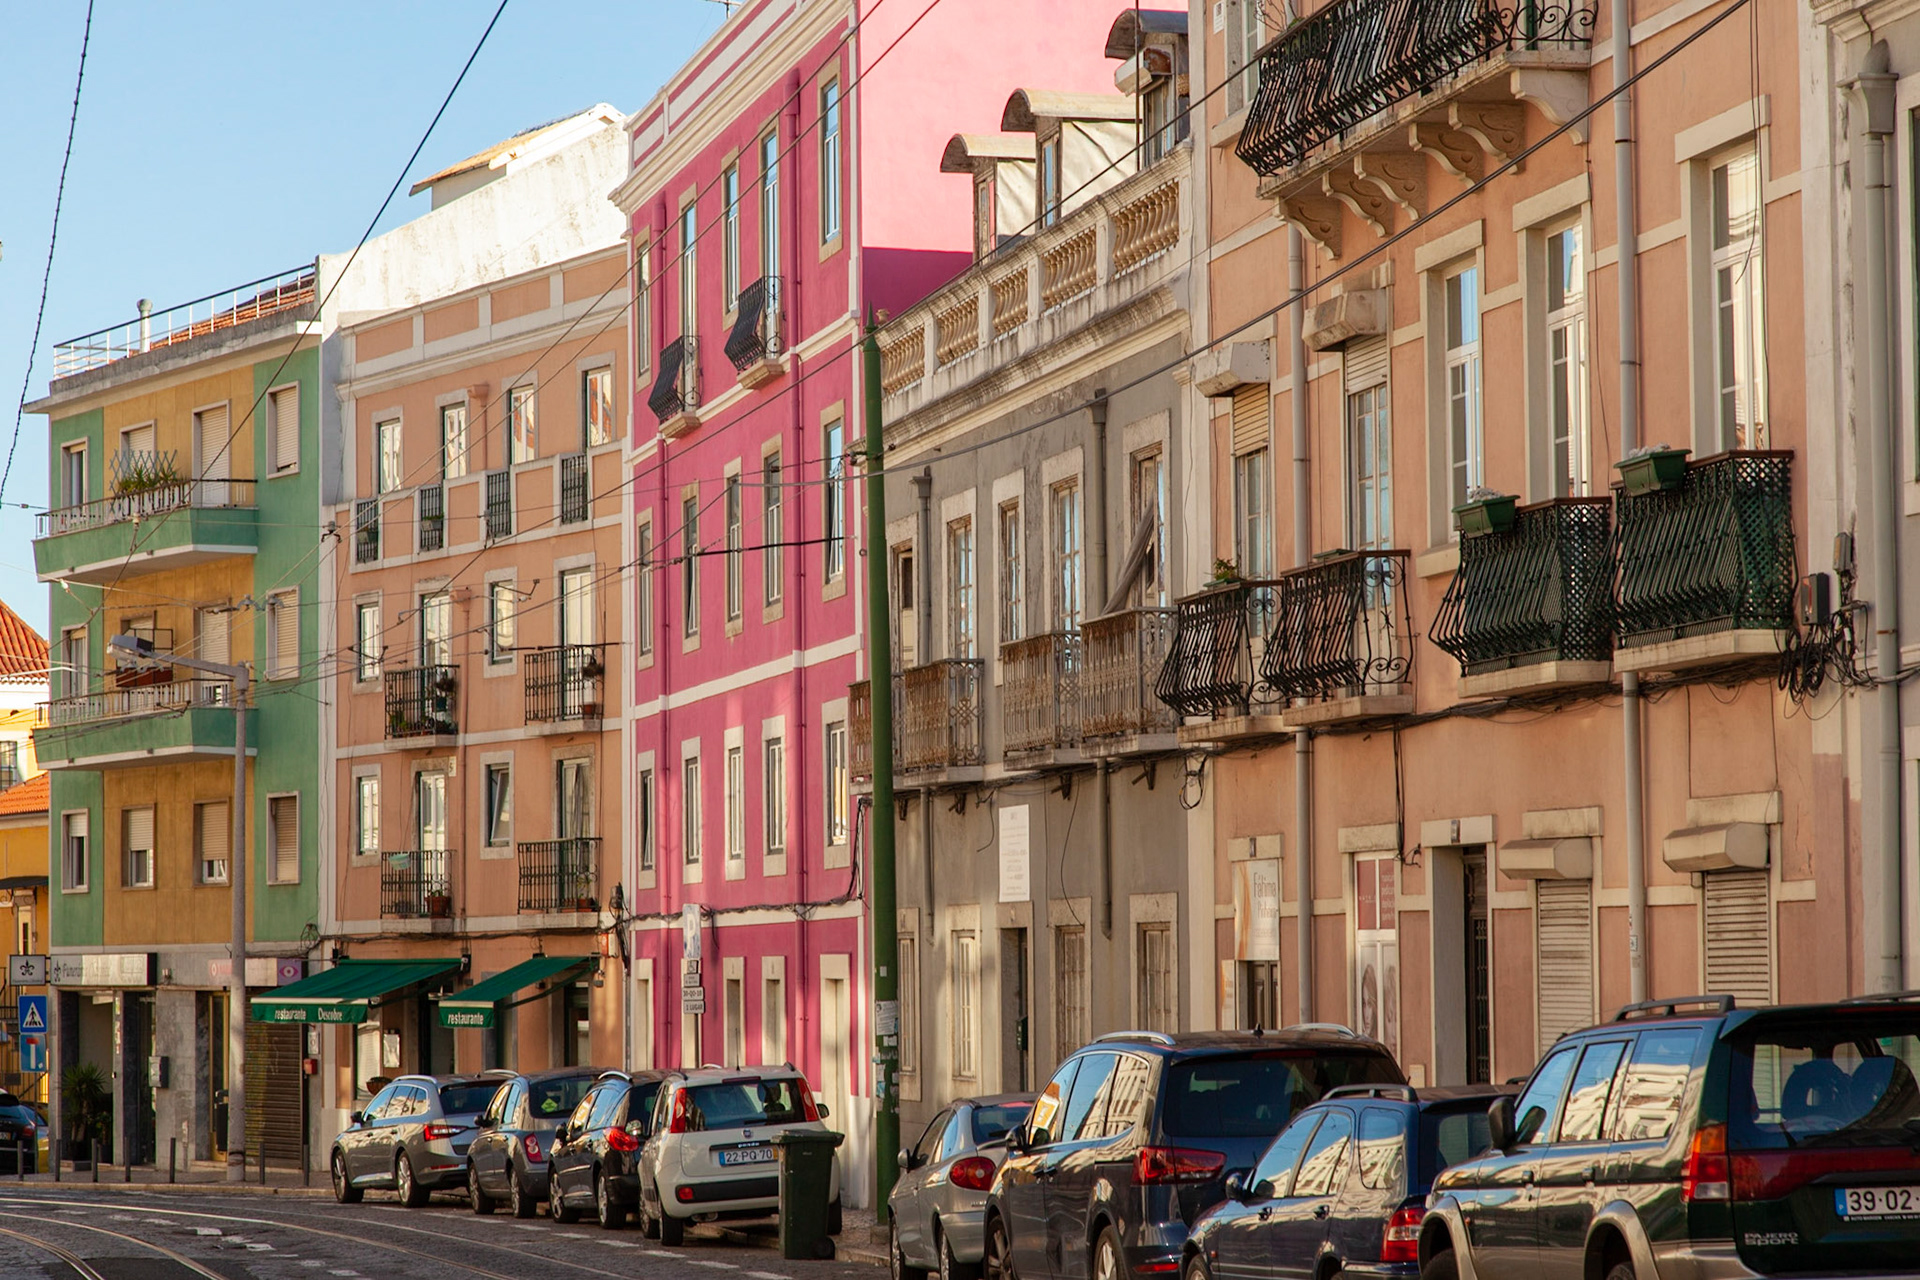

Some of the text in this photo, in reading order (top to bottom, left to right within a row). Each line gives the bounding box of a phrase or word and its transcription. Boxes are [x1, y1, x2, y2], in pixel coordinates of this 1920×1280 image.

[274, 1007, 343, 1020] restaurante Descobre
[447, 1011, 484, 1025] restaurante
